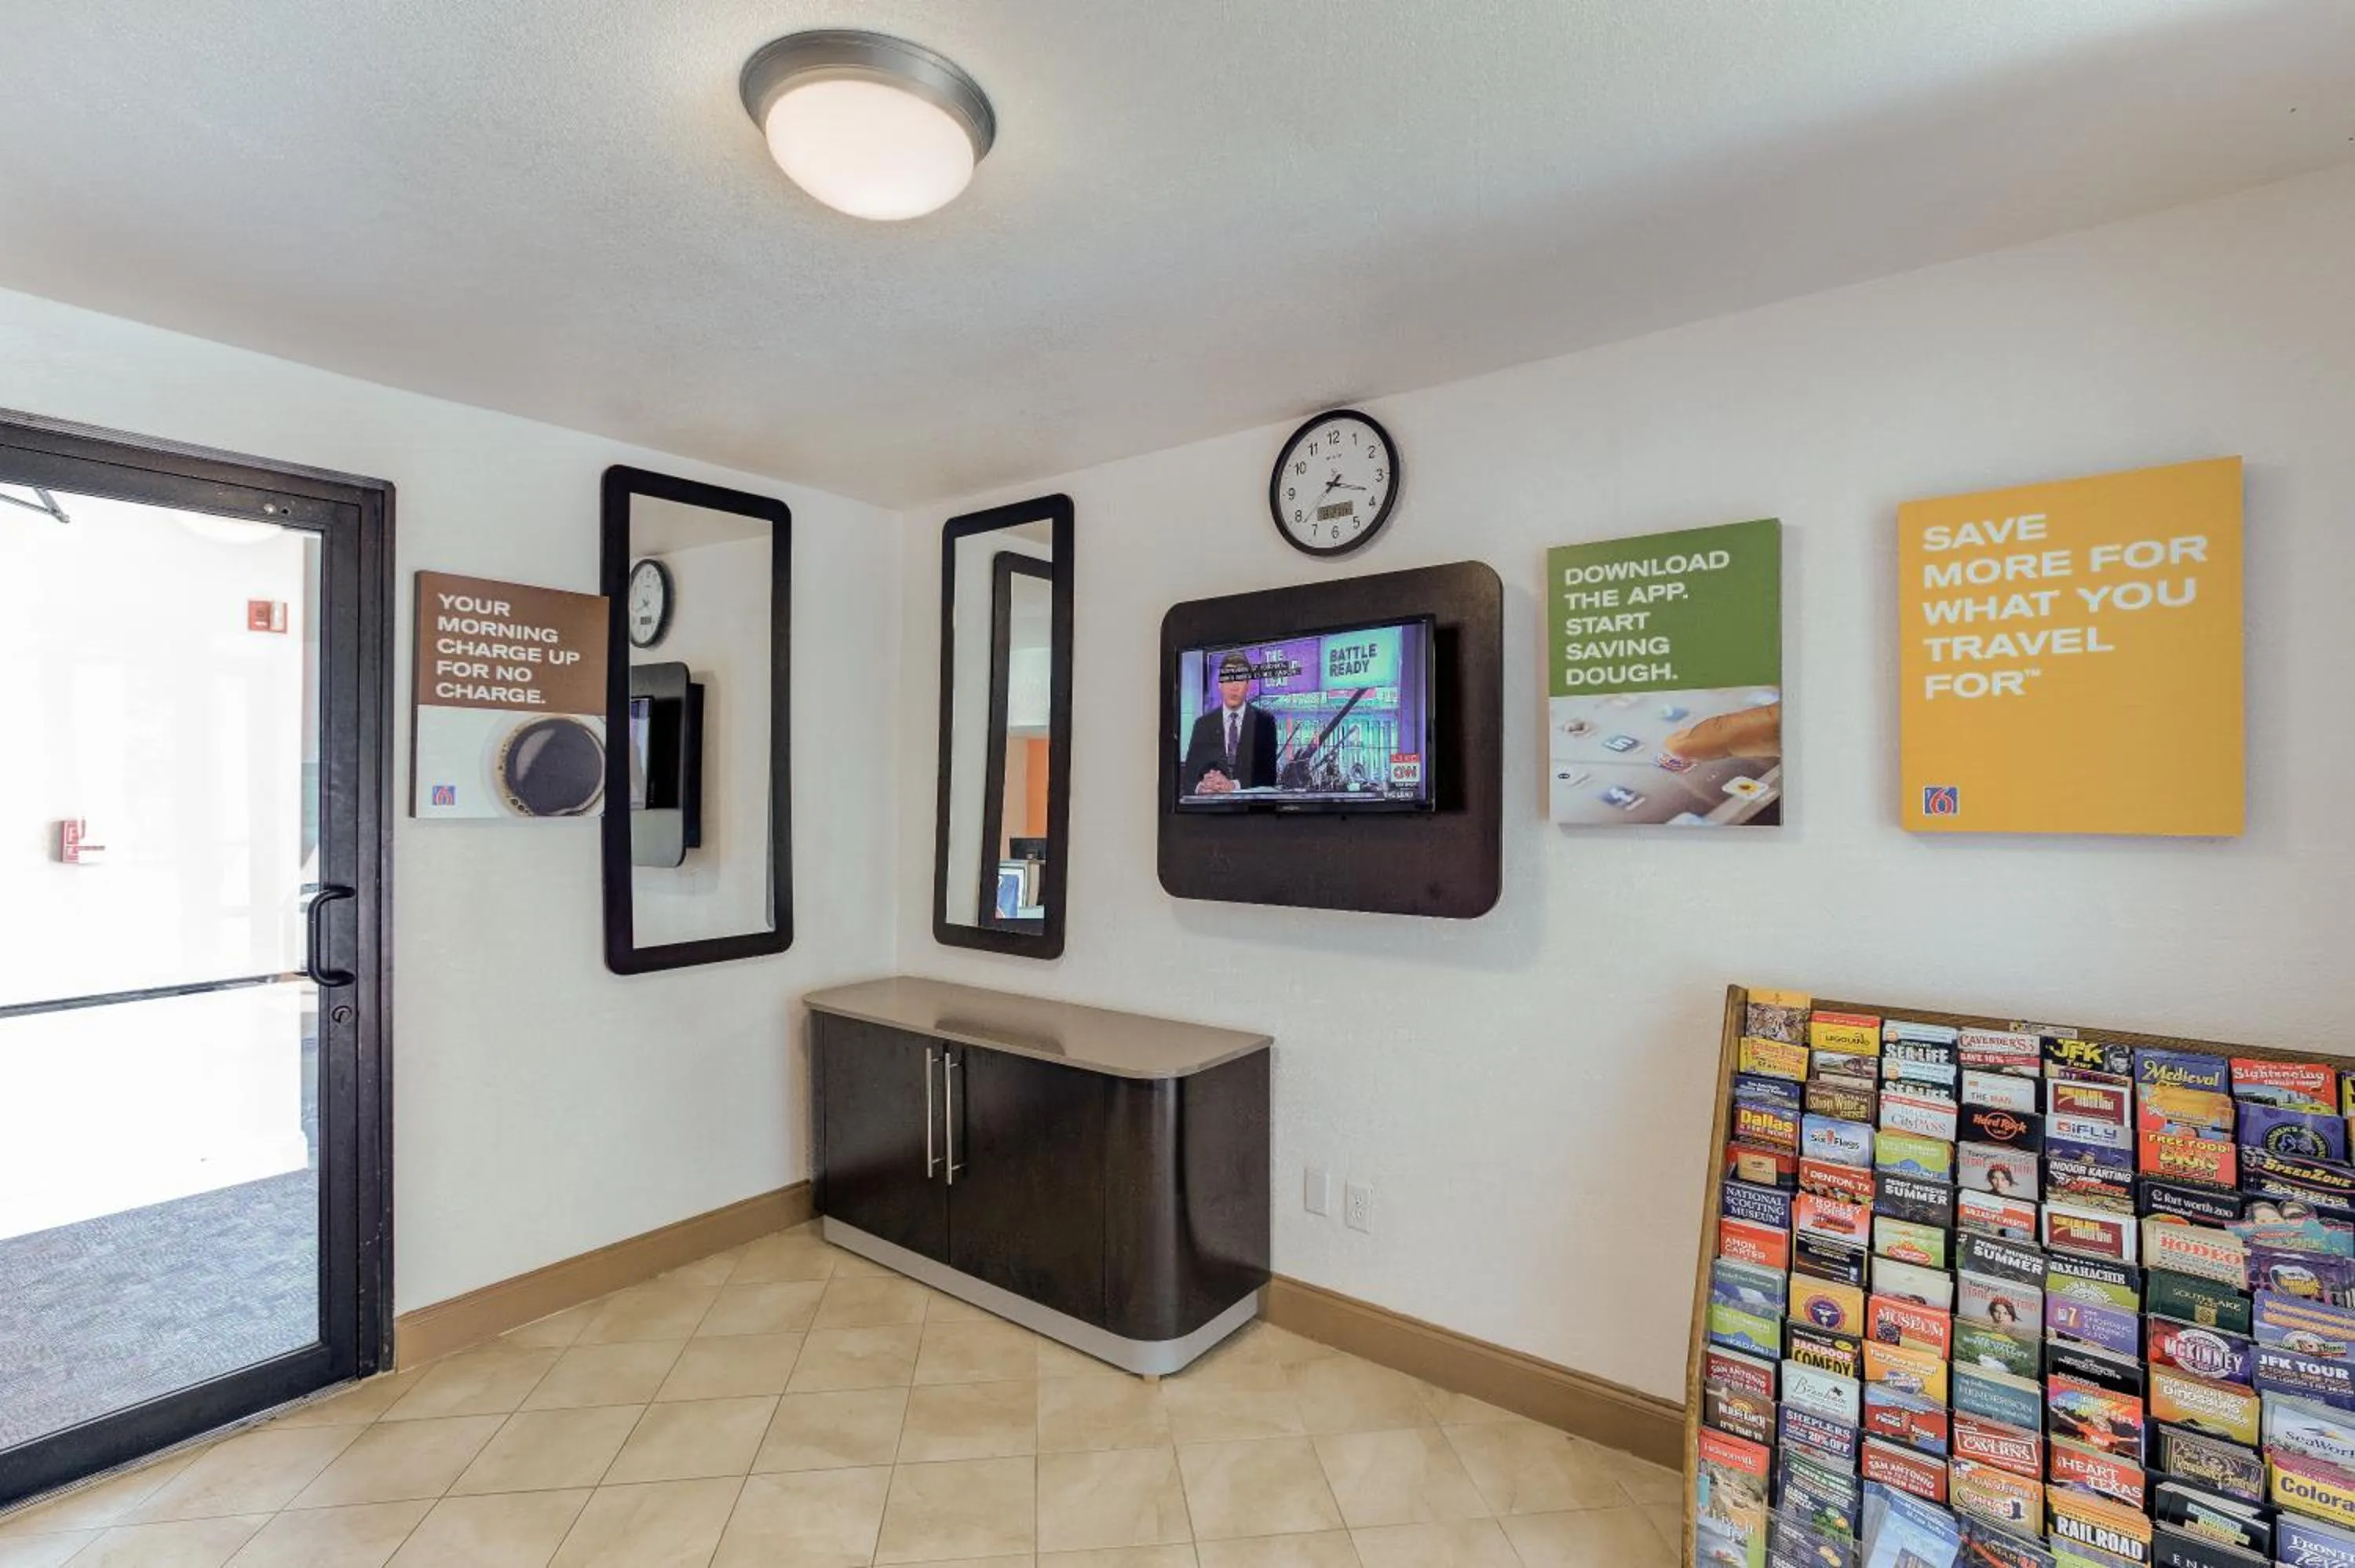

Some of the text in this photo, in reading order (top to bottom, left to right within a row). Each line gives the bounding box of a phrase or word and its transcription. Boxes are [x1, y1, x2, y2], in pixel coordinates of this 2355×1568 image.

[1327, 430, 1340, 444] 12
[1352, 433, 1357, 445] 1
[1309, 443, 1318, 457] 11
[1368, 445, 1376, 458] 2
[1295, 461, 1306, 476] 10
[1375, 469, 1384, 482] 3
[1288, 487, 1295, 501] 9
[1368, 496, 1375, 506] 4
[1295, 510, 1302, 523] 8
[1353, 516, 1360, 528] 5
[1312, 523, 1318, 536] 7
[1331, 526, 1339, 538] 6
[1922, 514, 2047, 551] SAVE
[1565, 550, 1730, 586] DOWNLOAD
[1923, 535, 2208, 589] MORE FOR
[437, 593, 510, 617] YOUR
[1565, 582, 1689, 610] THE APP.
[1922, 578, 2197, 626] WHAT YOU
[437, 616, 559, 644] MORNING
[1565, 612, 1650, 636] START
[436, 638, 580, 665] CHARGE UP
[1330, 643, 1378, 662] BATTLE
[1565, 636, 1670, 661] SAVING
[1922, 627, 2114, 662] TRAVEL
[436, 660, 532, 683] FOR NO
[1330, 659, 1371, 677] READY
[1566, 663, 1678, 686] DOUGH.
[436, 682, 546, 705] CHARGE.
[2054, 1038, 2104, 1064] JFK
[2142, 1060, 2220, 1086] Medieval
[2234, 1067, 2324, 1081] Sightseeing
[1971, 1092, 1987, 1100] THE
[1740, 1109, 1794, 1133] Dallas
[1973, 1114, 2027, 1134] Hard Rock
[2072, 1123, 2117, 1139] iFLY
[2149, 1133, 2183, 1145] FREE
[2050, 1161, 2087, 1175] INDOOR
[2088, 1166, 2131, 1183] KARTING
[1727, 1186, 1783, 1206] NATIONAL
[1857, 1182, 1871, 1193] TX
[1885, 1184, 1948, 1206] SUMMER
[1726, 1196, 1784, 1216] SCOUTING
[2164, 1192, 2182, 1206] fort
[2184, 1200, 2214, 1214] worth
[1731, 1206, 1780, 1225] MUSEUM
[1725, 1236, 1757, 1250] AMON
[1725, 1245, 1766, 1260] CARTER
[1973, 1245, 2043, 1275] SUMMER
[2005, 1246, 2043, 1264] MUSEUM
[1793, 1337, 1851, 1359] BACKDOOR
[1794, 1349, 1851, 1377] COMEDY
[2258, 1354, 2291, 1369] JFK
[2295, 1361, 2350, 1380] TOUR
[1959, 1385, 2034, 1413] HENDERSON
[1785, 1409, 1851, 1440] SHEPLERS
[1808, 1431, 1851, 1453] 20% OFF
[1869, 1460, 1935, 1490] SAN ANTONIO
[2086, 1475, 2142, 1499] TEXAS
[2056, 1515, 2143, 1560] RAILROAD
